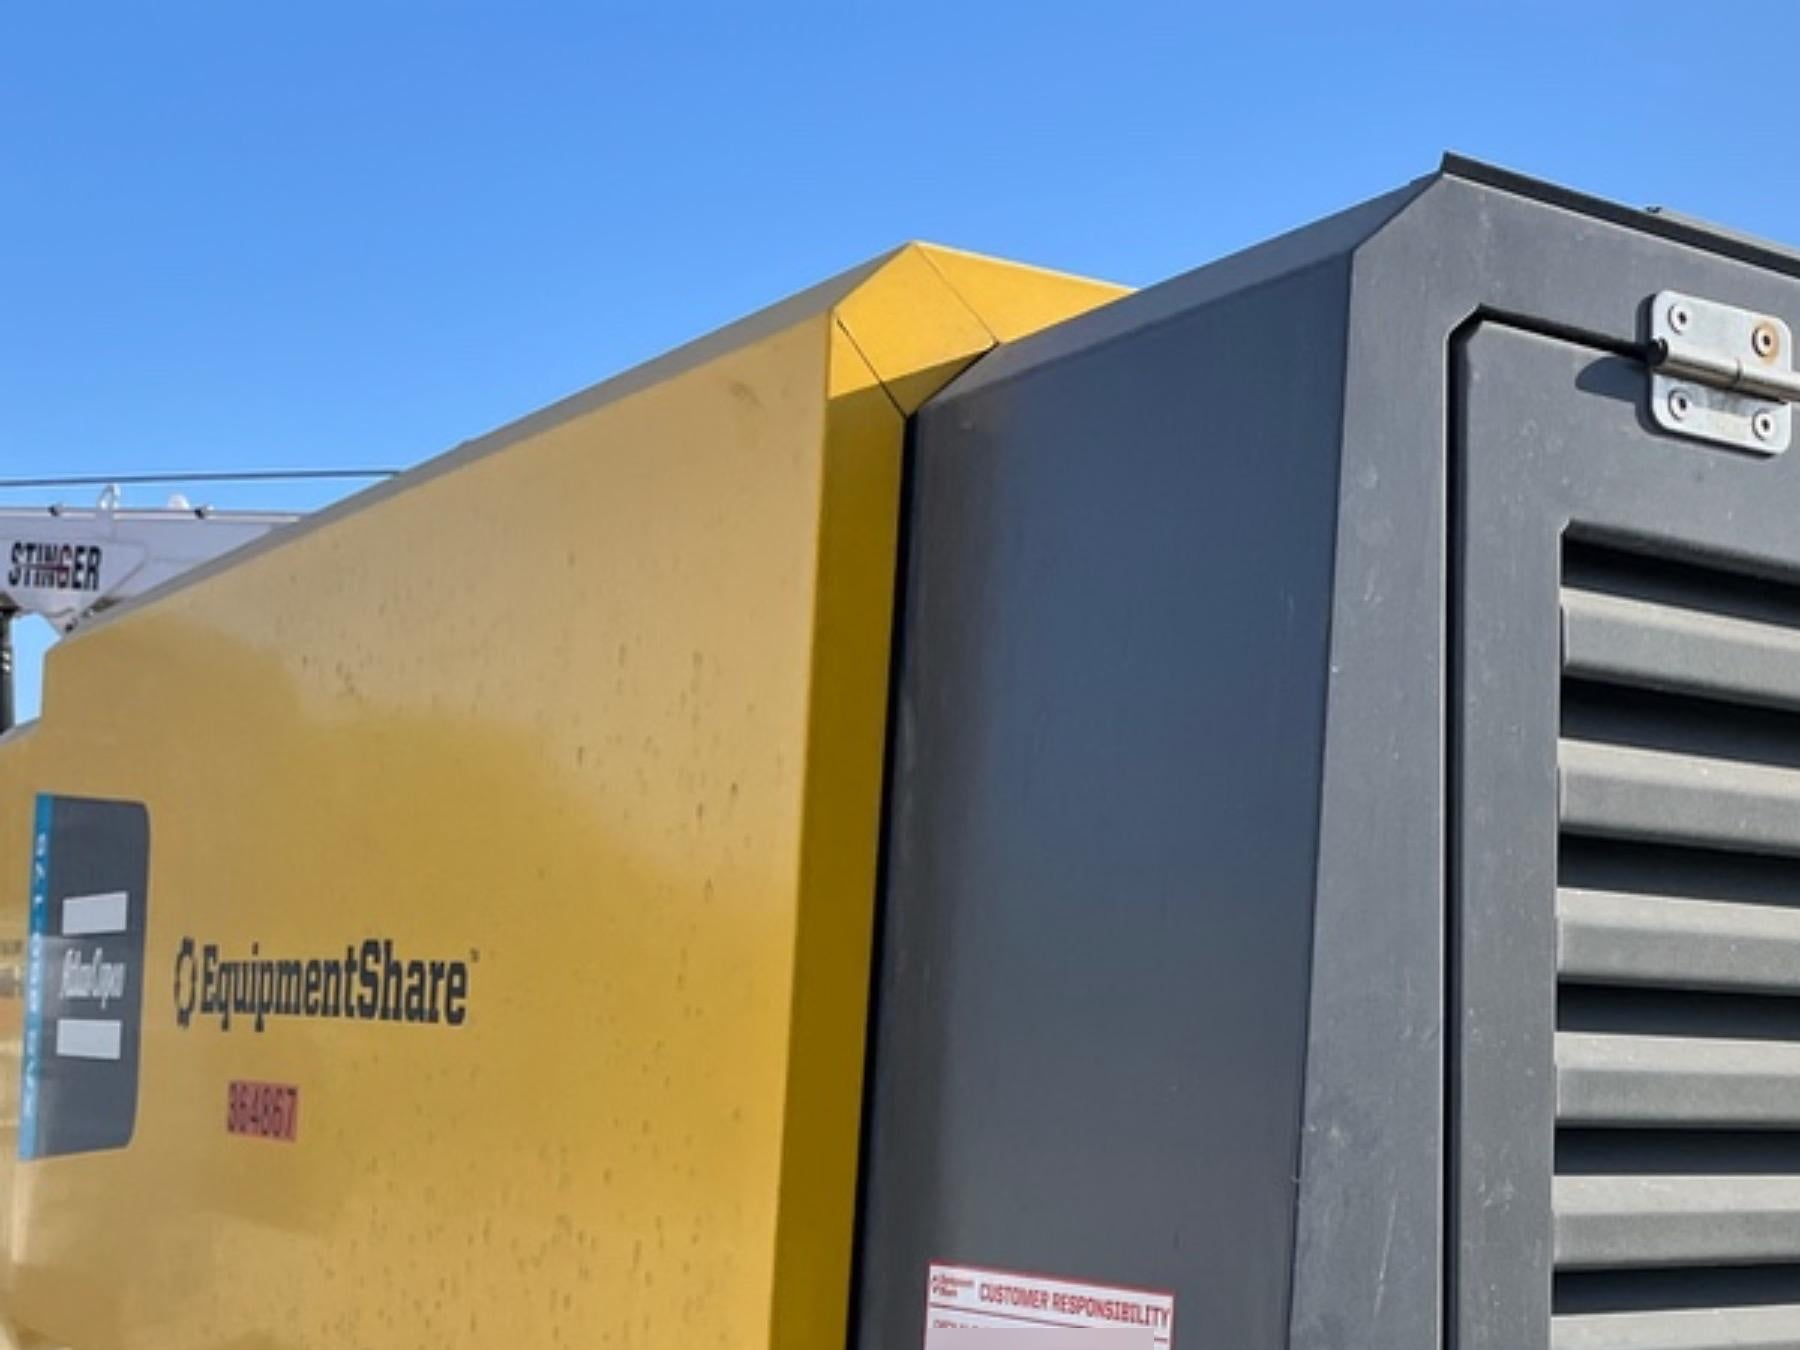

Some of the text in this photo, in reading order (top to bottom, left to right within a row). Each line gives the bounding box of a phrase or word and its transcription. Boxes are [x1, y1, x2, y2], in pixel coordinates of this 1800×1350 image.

[8, 542, 102, 592] STINGER
[200, 939, 468, 1032] EquipmentShare
[978, 1283, 1049, 1312] CUSTOMER
[1052, 1292, 1171, 1327] RESPONSIBILITY
